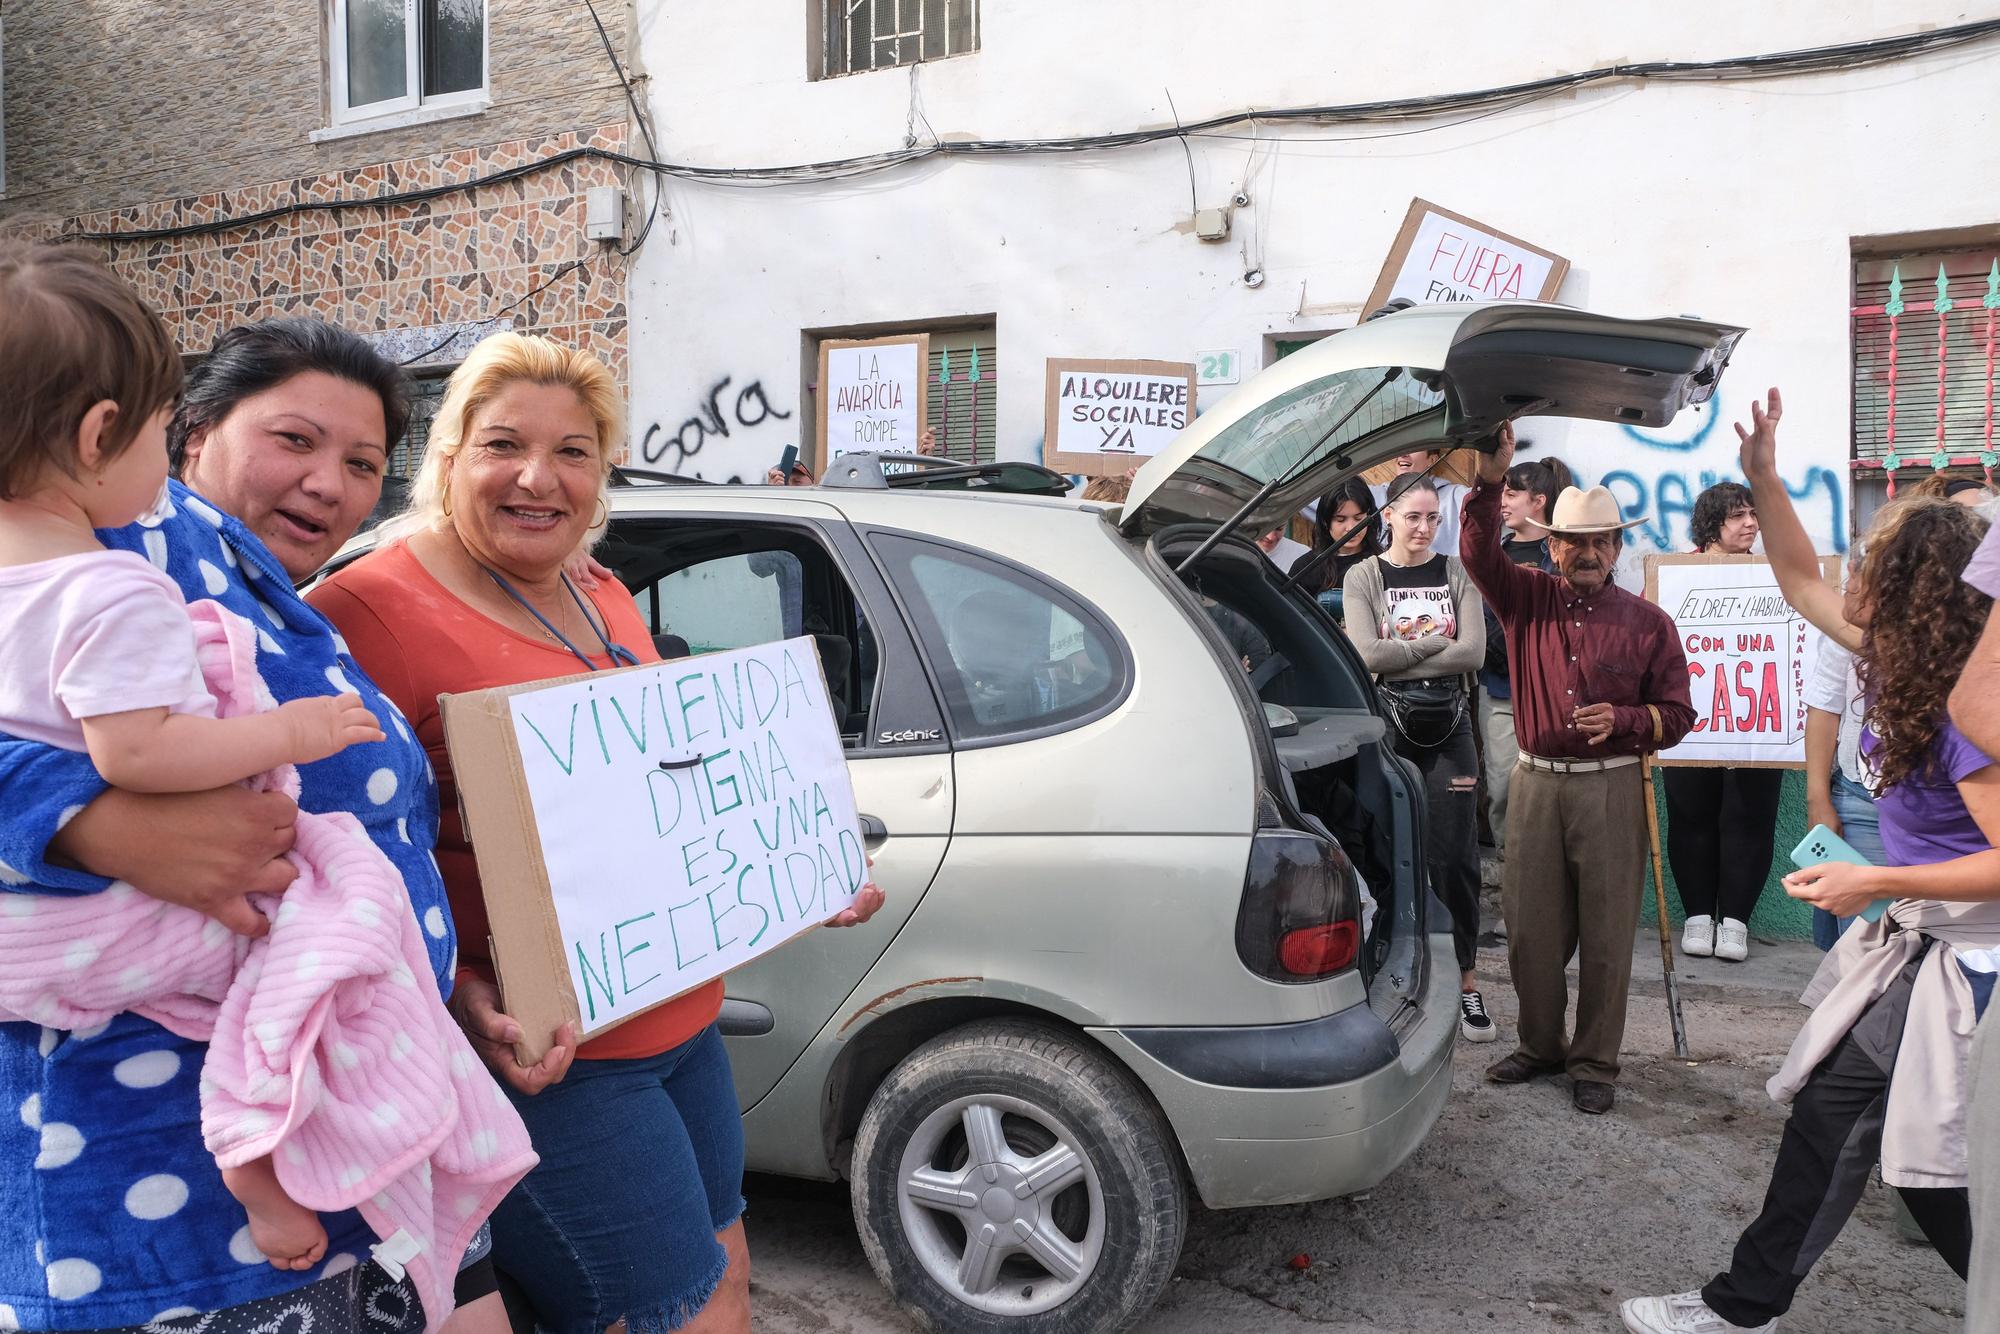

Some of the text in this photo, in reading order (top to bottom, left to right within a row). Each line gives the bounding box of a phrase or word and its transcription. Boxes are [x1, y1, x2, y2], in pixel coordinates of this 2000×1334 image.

[1429, 232, 1522, 299] FUERA
[858, 353, 880, 381] LA
[1201, 352, 1230, 378] 21
[837, 379, 903, 413] AVARICIA
[1062, 376, 1187, 405] ALQUILERE
[1073, 404, 1185, 430] SOCIALES
[1100, 426, 1135, 448] YA
[1423, 589, 1449, 601] TODO
[1441, 602, 1453, 614] EL
[1680, 597, 1699, 618] EL
[1700, 597, 1739, 618] DRET
[1686, 634, 1775, 654] COM UNA
[1688, 661, 1782, 733] CASA
[521, 649, 812, 775] VIVIENDA
[878, 729, 940, 744] Scénic
[646, 731, 795, 839] DIGNA
[682, 781, 833, 887] ES UNA
[576, 828, 864, 1022] NECESIDAD
